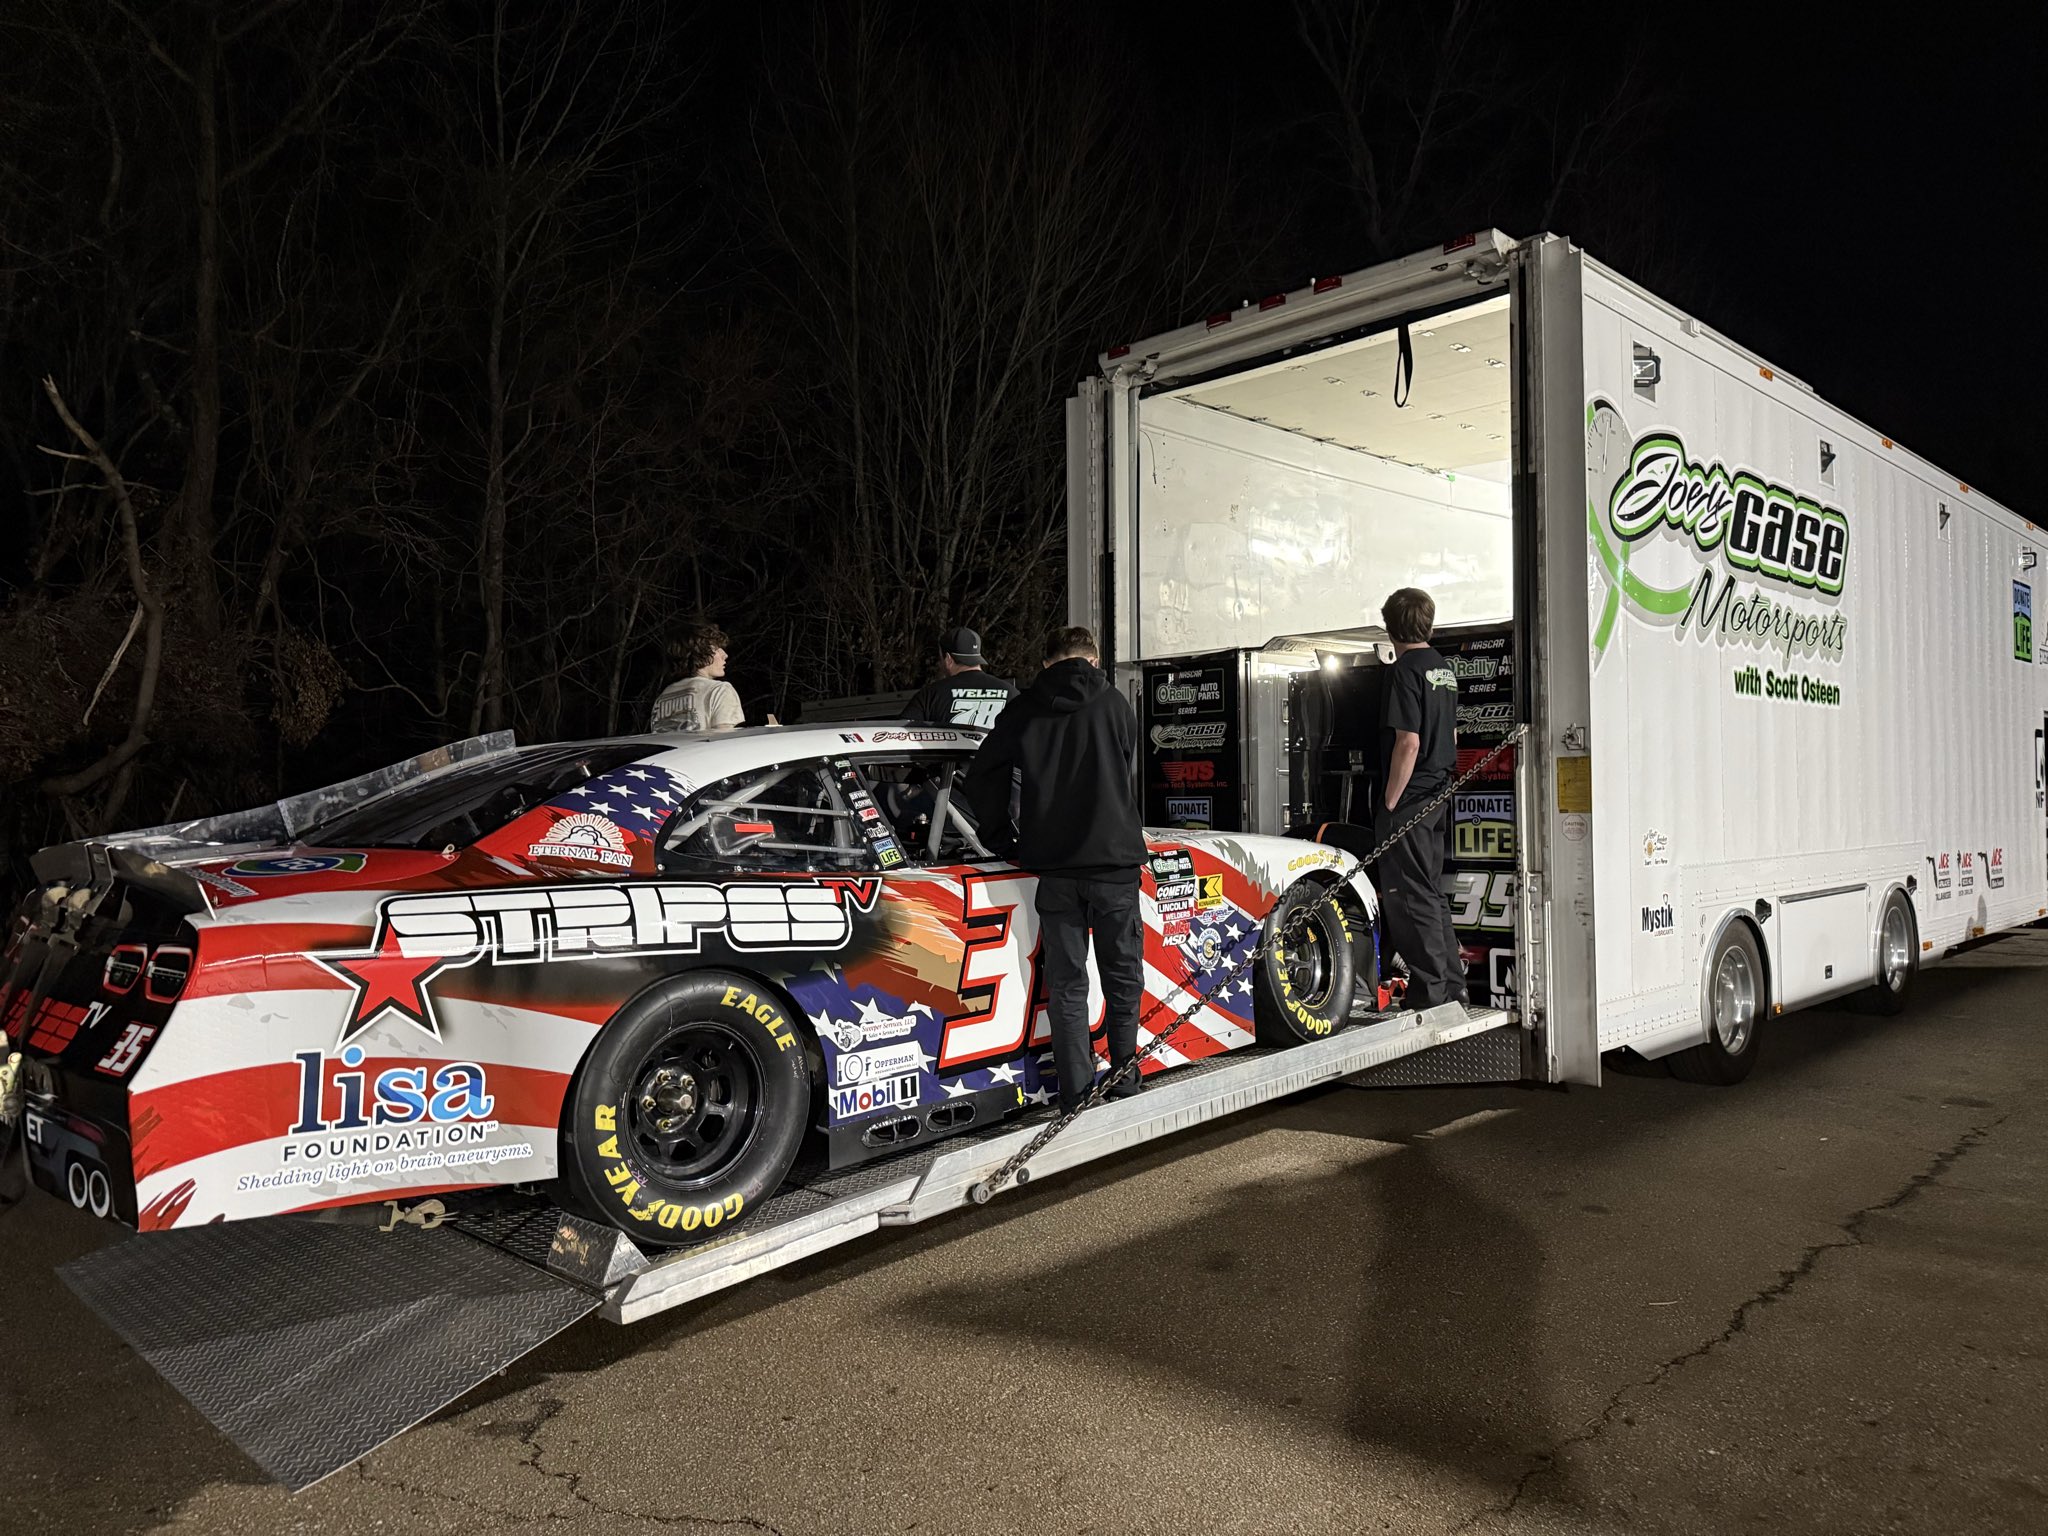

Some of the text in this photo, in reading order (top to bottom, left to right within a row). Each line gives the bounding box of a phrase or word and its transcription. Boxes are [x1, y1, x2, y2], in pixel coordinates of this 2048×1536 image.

[1616, 452, 1734, 534] Joey
[1680, 569, 1846, 659] Motorsports
[1471, 638, 1505, 651] NASCAR
[951, 689, 1009, 698] WELCH
[1156, 683, 1199, 704] O'Reilly
[1198, 691, 1221, 701] PARTS
[1200, 682, 1218, 691] AUTO
[1468, 683, 1497, 693] SERIES
[1734, 668, 1841, 706] with Scott Osteen
[950, 699, 1007, 730] 78
[1177, 706, 1198, 716] SERIES
[1170, 802, 1208, 815] DONATE
[1458, 798, 1512, 813] DONATE
[1459, 827, 1512, 854] LIFE
[530, 845, 631, 866] ETERNAL FAN
[881, 850, 900, 864] LIFE
[387, 880, 877, 959] STRIPES TV
[1159, 900, 1188, 912] LINCOLN
[1165, 910, 1191, 920] WELDERS
[1641, 904, 1674, 933] Mystik
[1329, 898, 1354, 944] AGLE
[1163, 935, 1187, 947] MSD
[80, 1000, 113, 1029] TV
[720, 985, 798, 1052] EAGLE
[97, 1022, 156, 1075] 35
[291, 1047, 493, 1135] lisa
[839, 1079, 896, 1116] Mobil
[283, 1123, 485, 1162] FOUNDATION
[237, 1143, 533, 1192] Shedding light on brain aneurysms.
[594, 1103, 745, 1232] GOODYEAR
